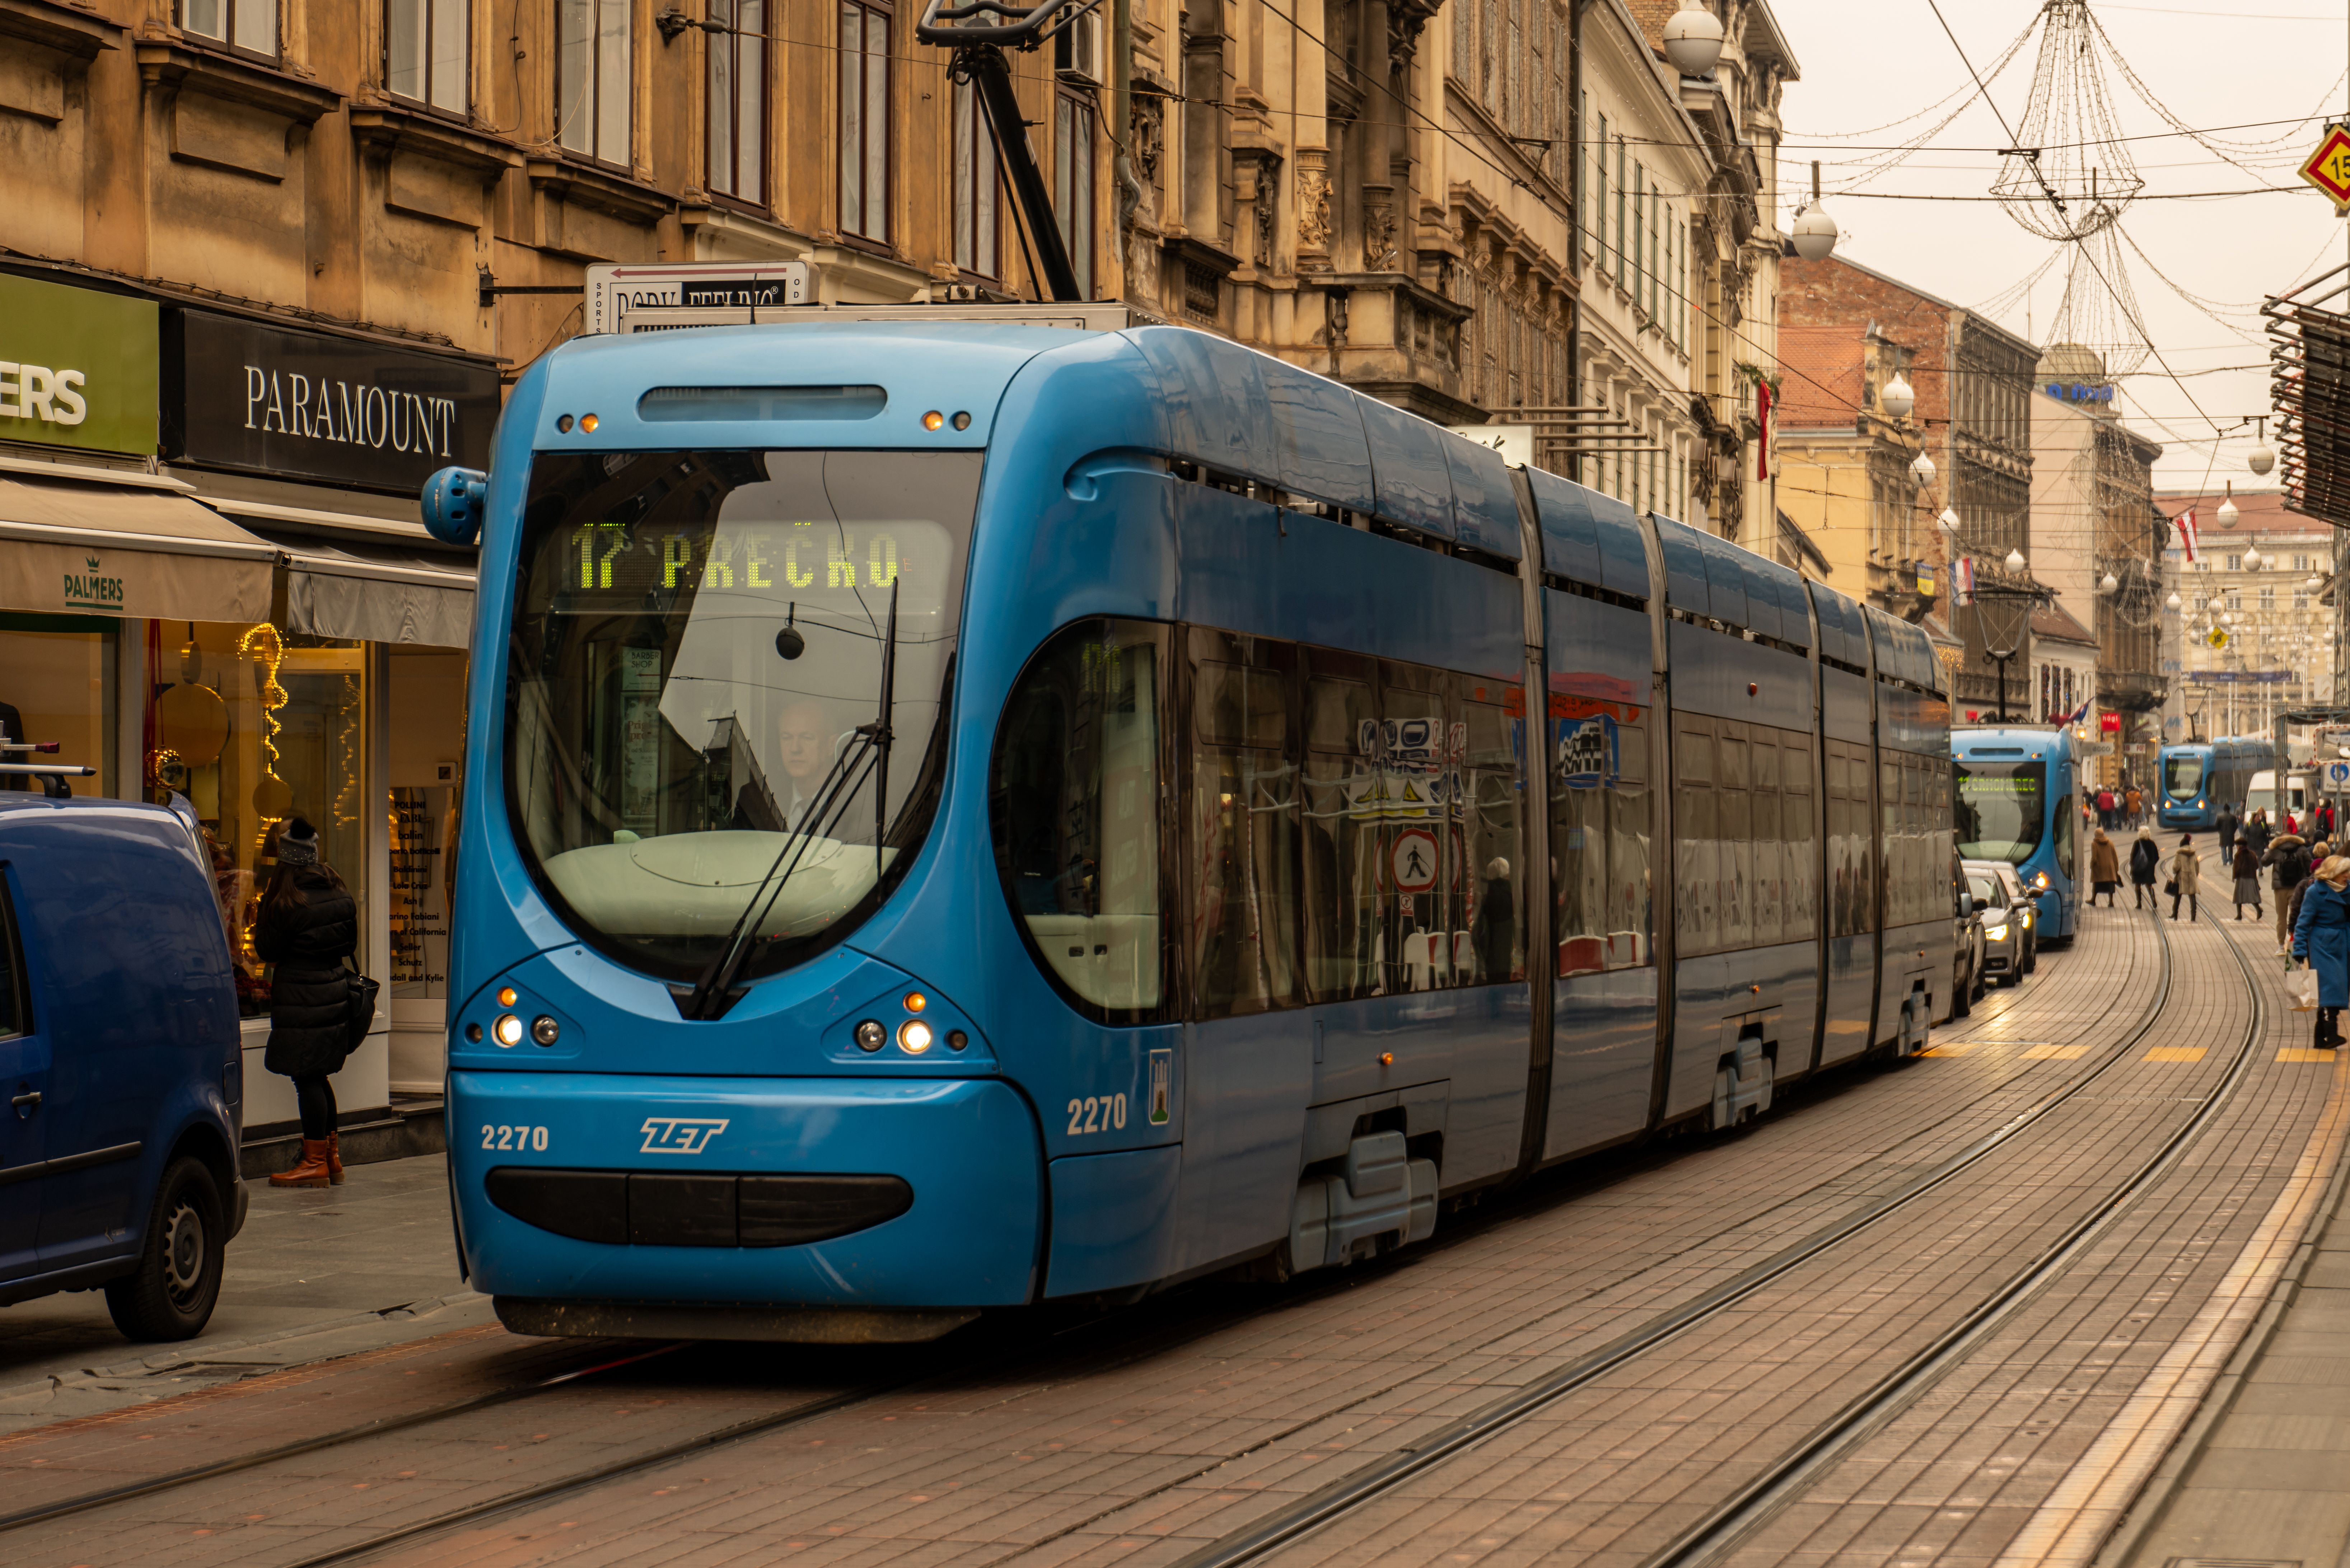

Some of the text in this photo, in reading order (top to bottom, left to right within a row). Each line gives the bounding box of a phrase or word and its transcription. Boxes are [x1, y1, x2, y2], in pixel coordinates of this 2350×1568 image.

[2331, 155, 2350, 179] 15
[244, 365, 455, 457] PARAMOUNT
[573, 523, 897, 588] 17 PREČKO
[64, 574, 123, 602] PALMERS
[400, 814, 421, 823] FABI
[398, 830, 423, 839] ballin
[425, 974, 444, 983] Kylie
[1067, 1092, 1126, 1135] 2270
[481, 1117, 730, 1155] 2270 ZET
